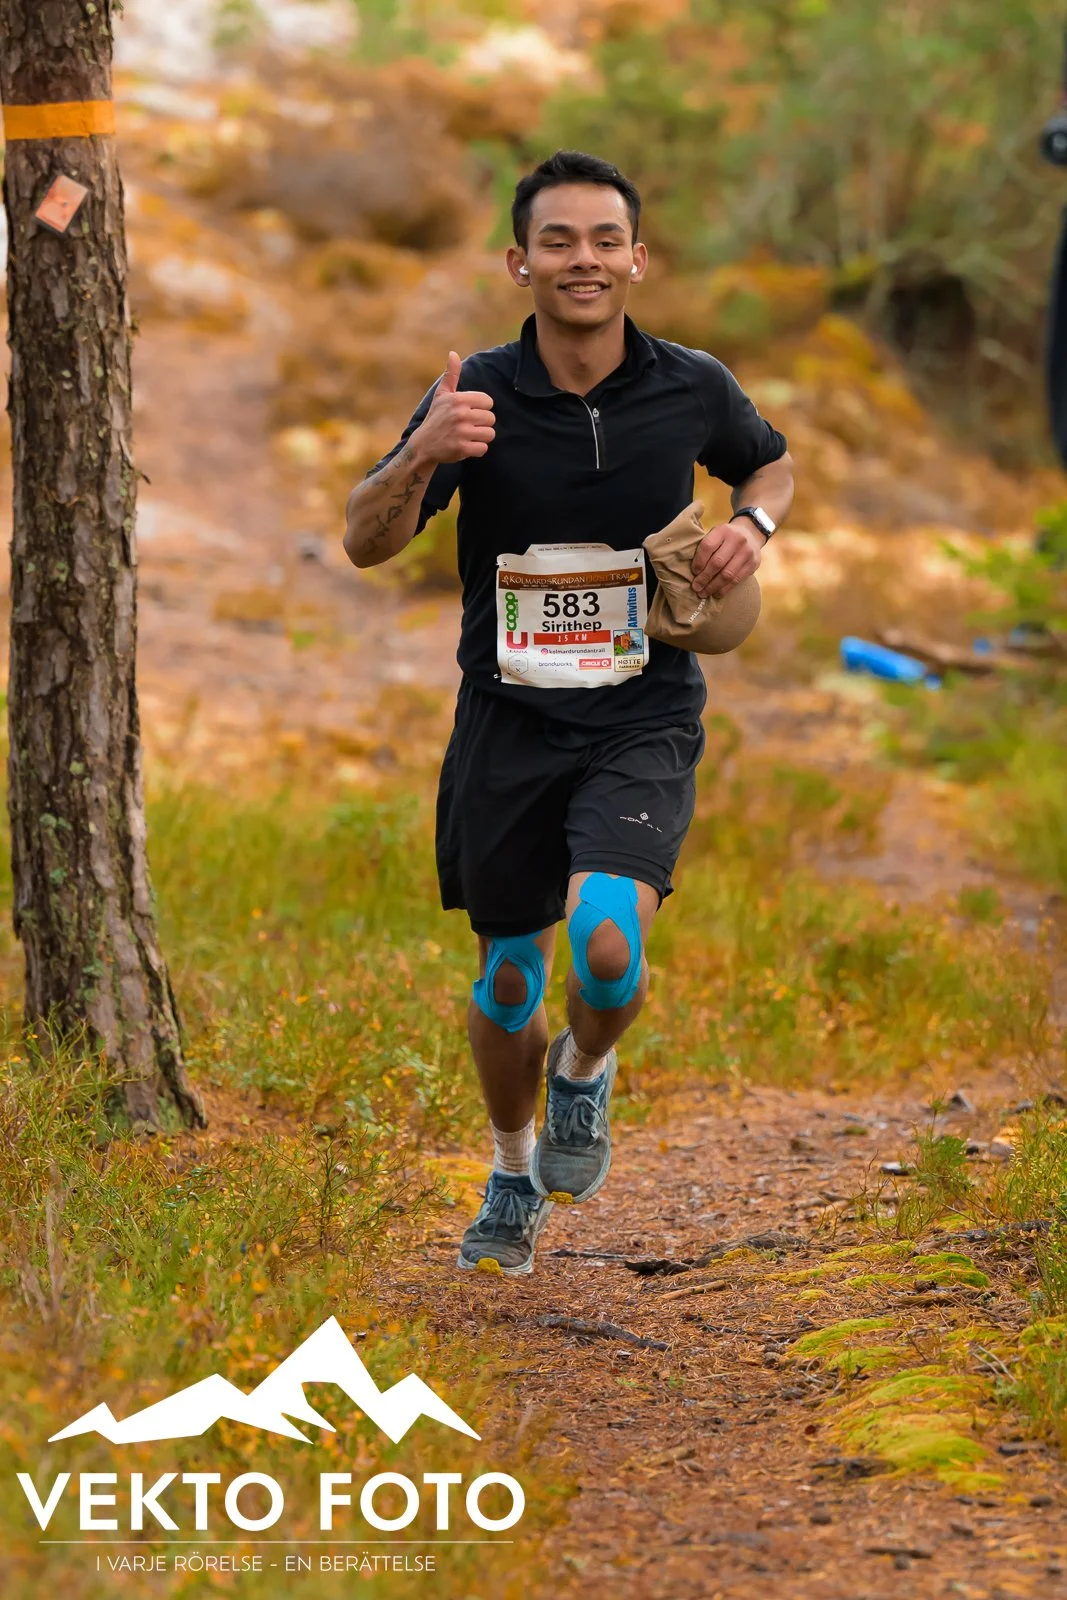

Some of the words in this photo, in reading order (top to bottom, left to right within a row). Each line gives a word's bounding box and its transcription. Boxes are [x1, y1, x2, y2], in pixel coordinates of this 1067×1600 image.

[505, 592, 518, 631] coop
[543, 592, 600, 618] 583
[627, 587, 638, 627] Aktivitus
[542, 620, 602, 633] Sirithep
[558, 633, 568, 642] 15
[574, 633, 587, 642] KM
